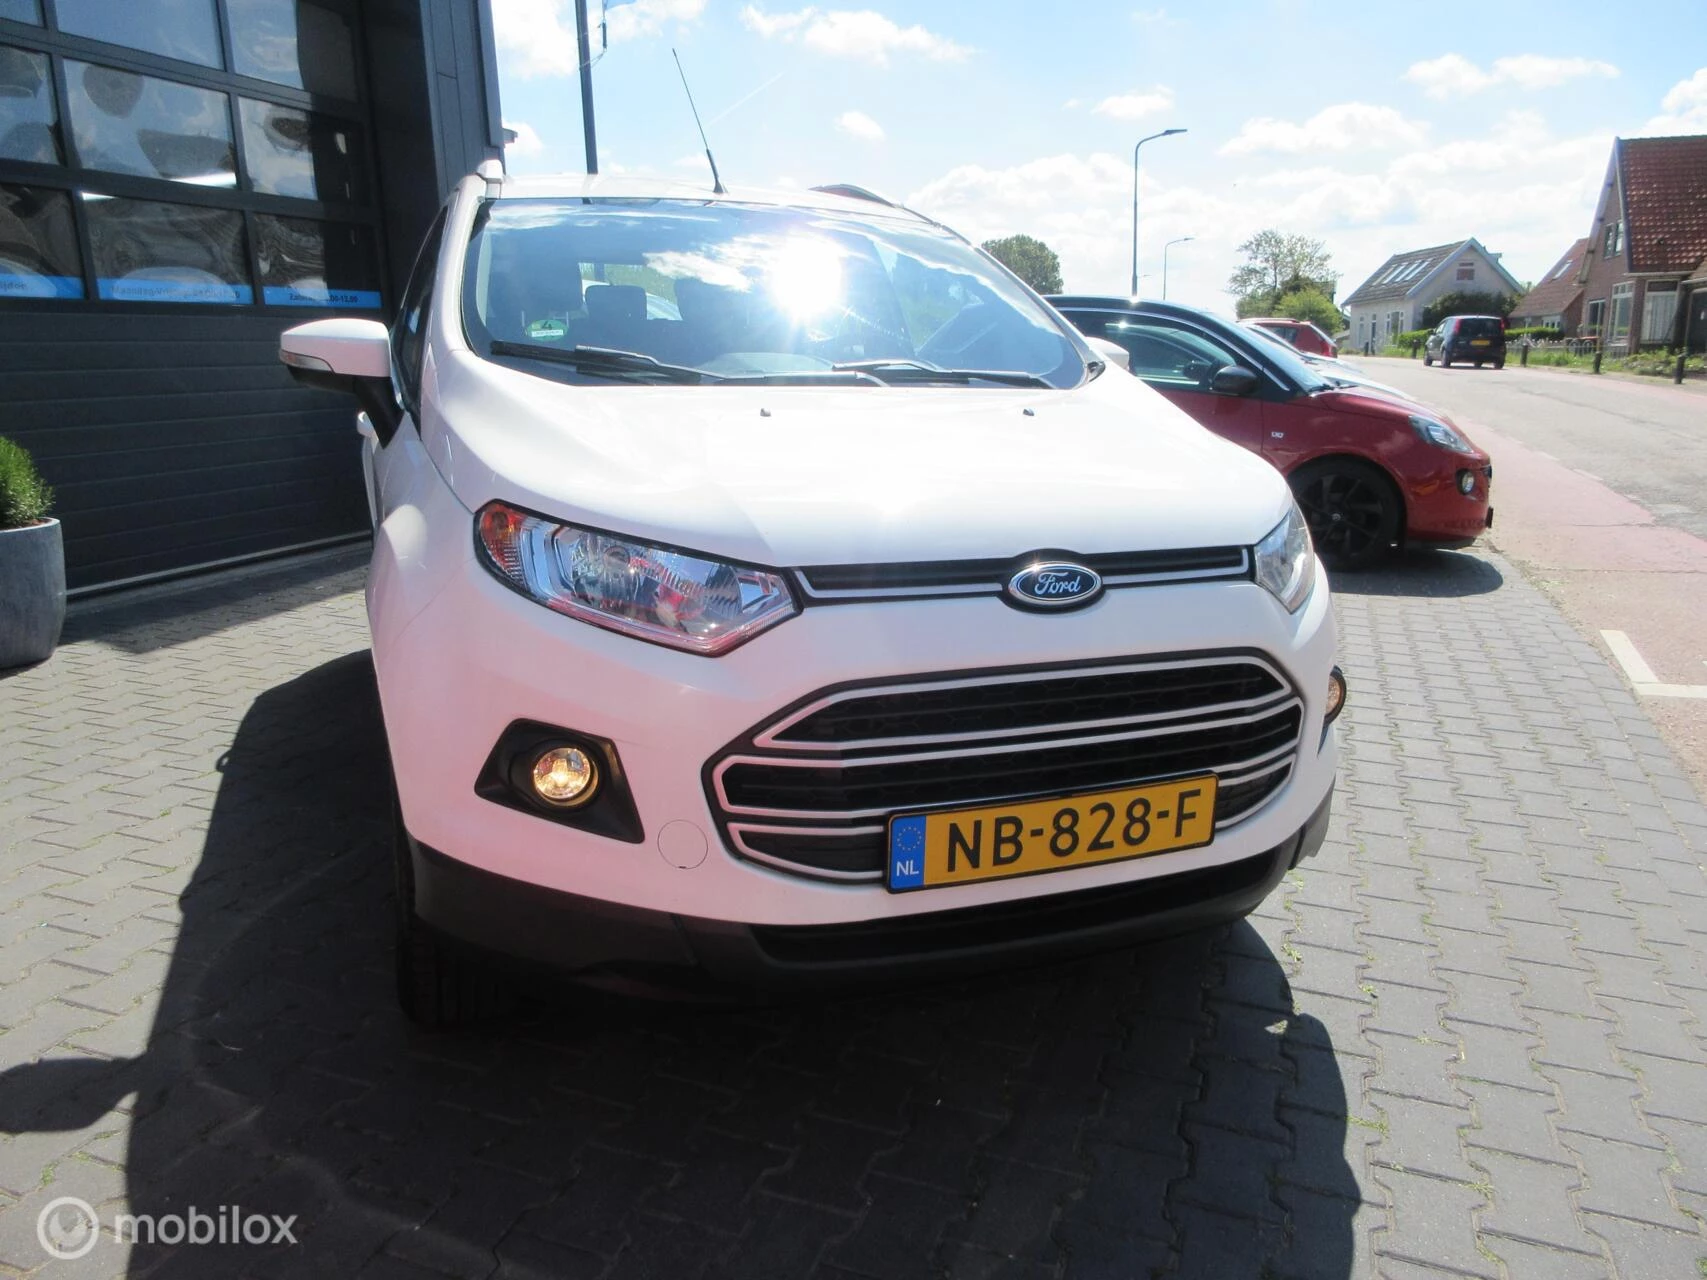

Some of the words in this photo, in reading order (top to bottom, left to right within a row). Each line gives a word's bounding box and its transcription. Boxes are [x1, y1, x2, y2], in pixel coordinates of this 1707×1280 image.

[541, 320, 553, 330] 4
[1034, 571, 1081, 595] Ford
[947, 788, 1201, 872] NB-828-F
[896, 859, 919, 877] NL
